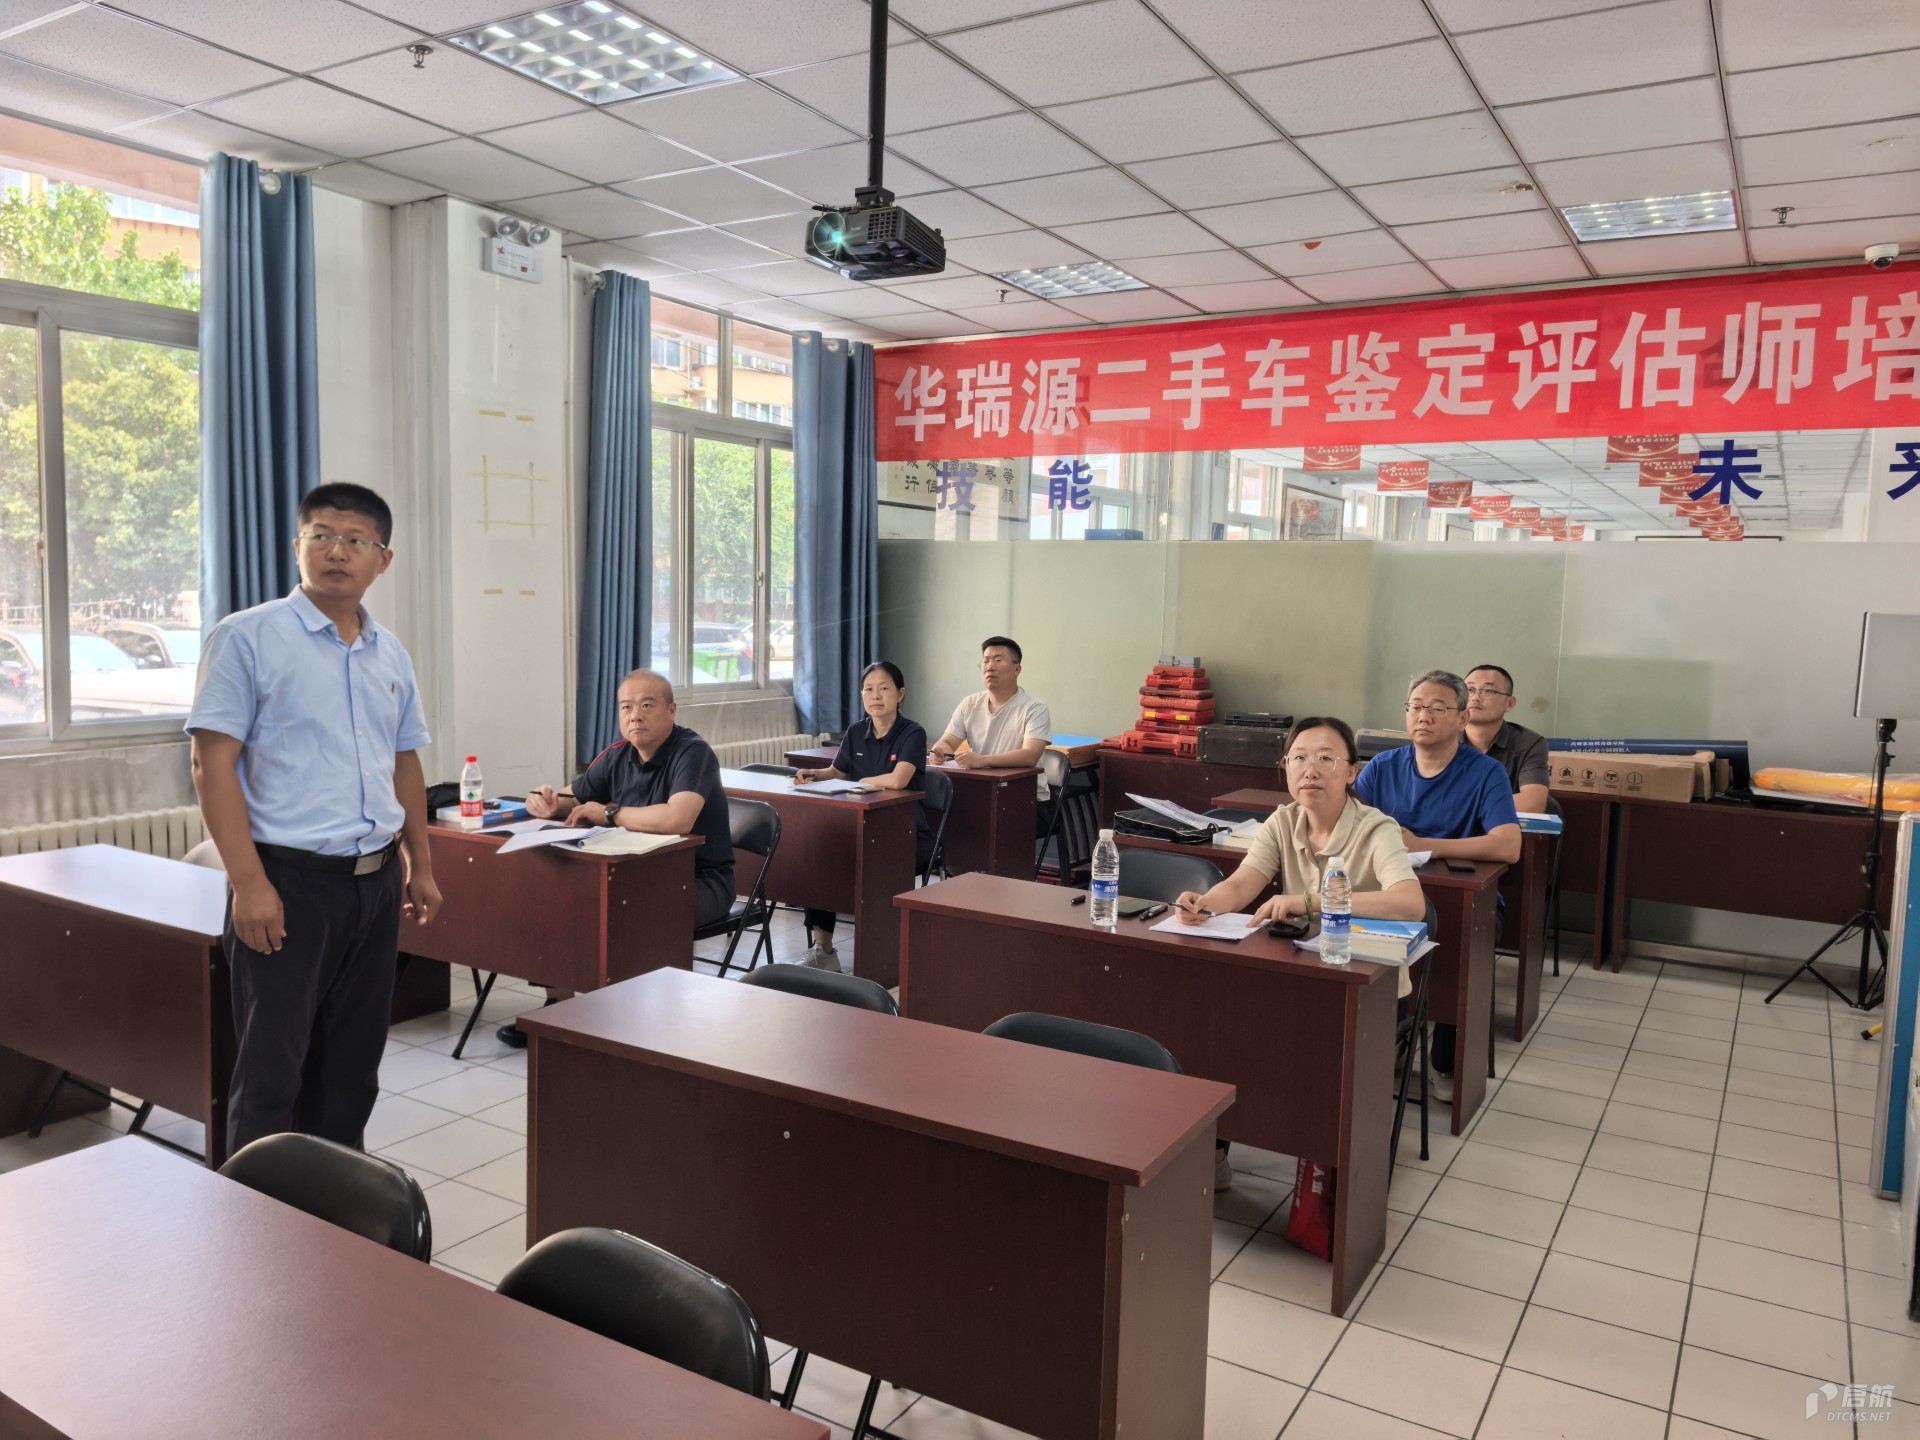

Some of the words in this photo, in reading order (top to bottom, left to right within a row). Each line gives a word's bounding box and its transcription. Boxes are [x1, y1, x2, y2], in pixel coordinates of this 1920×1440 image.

[894, 290, 1920, 442] 华瑞源二手车鉴定评估师培
